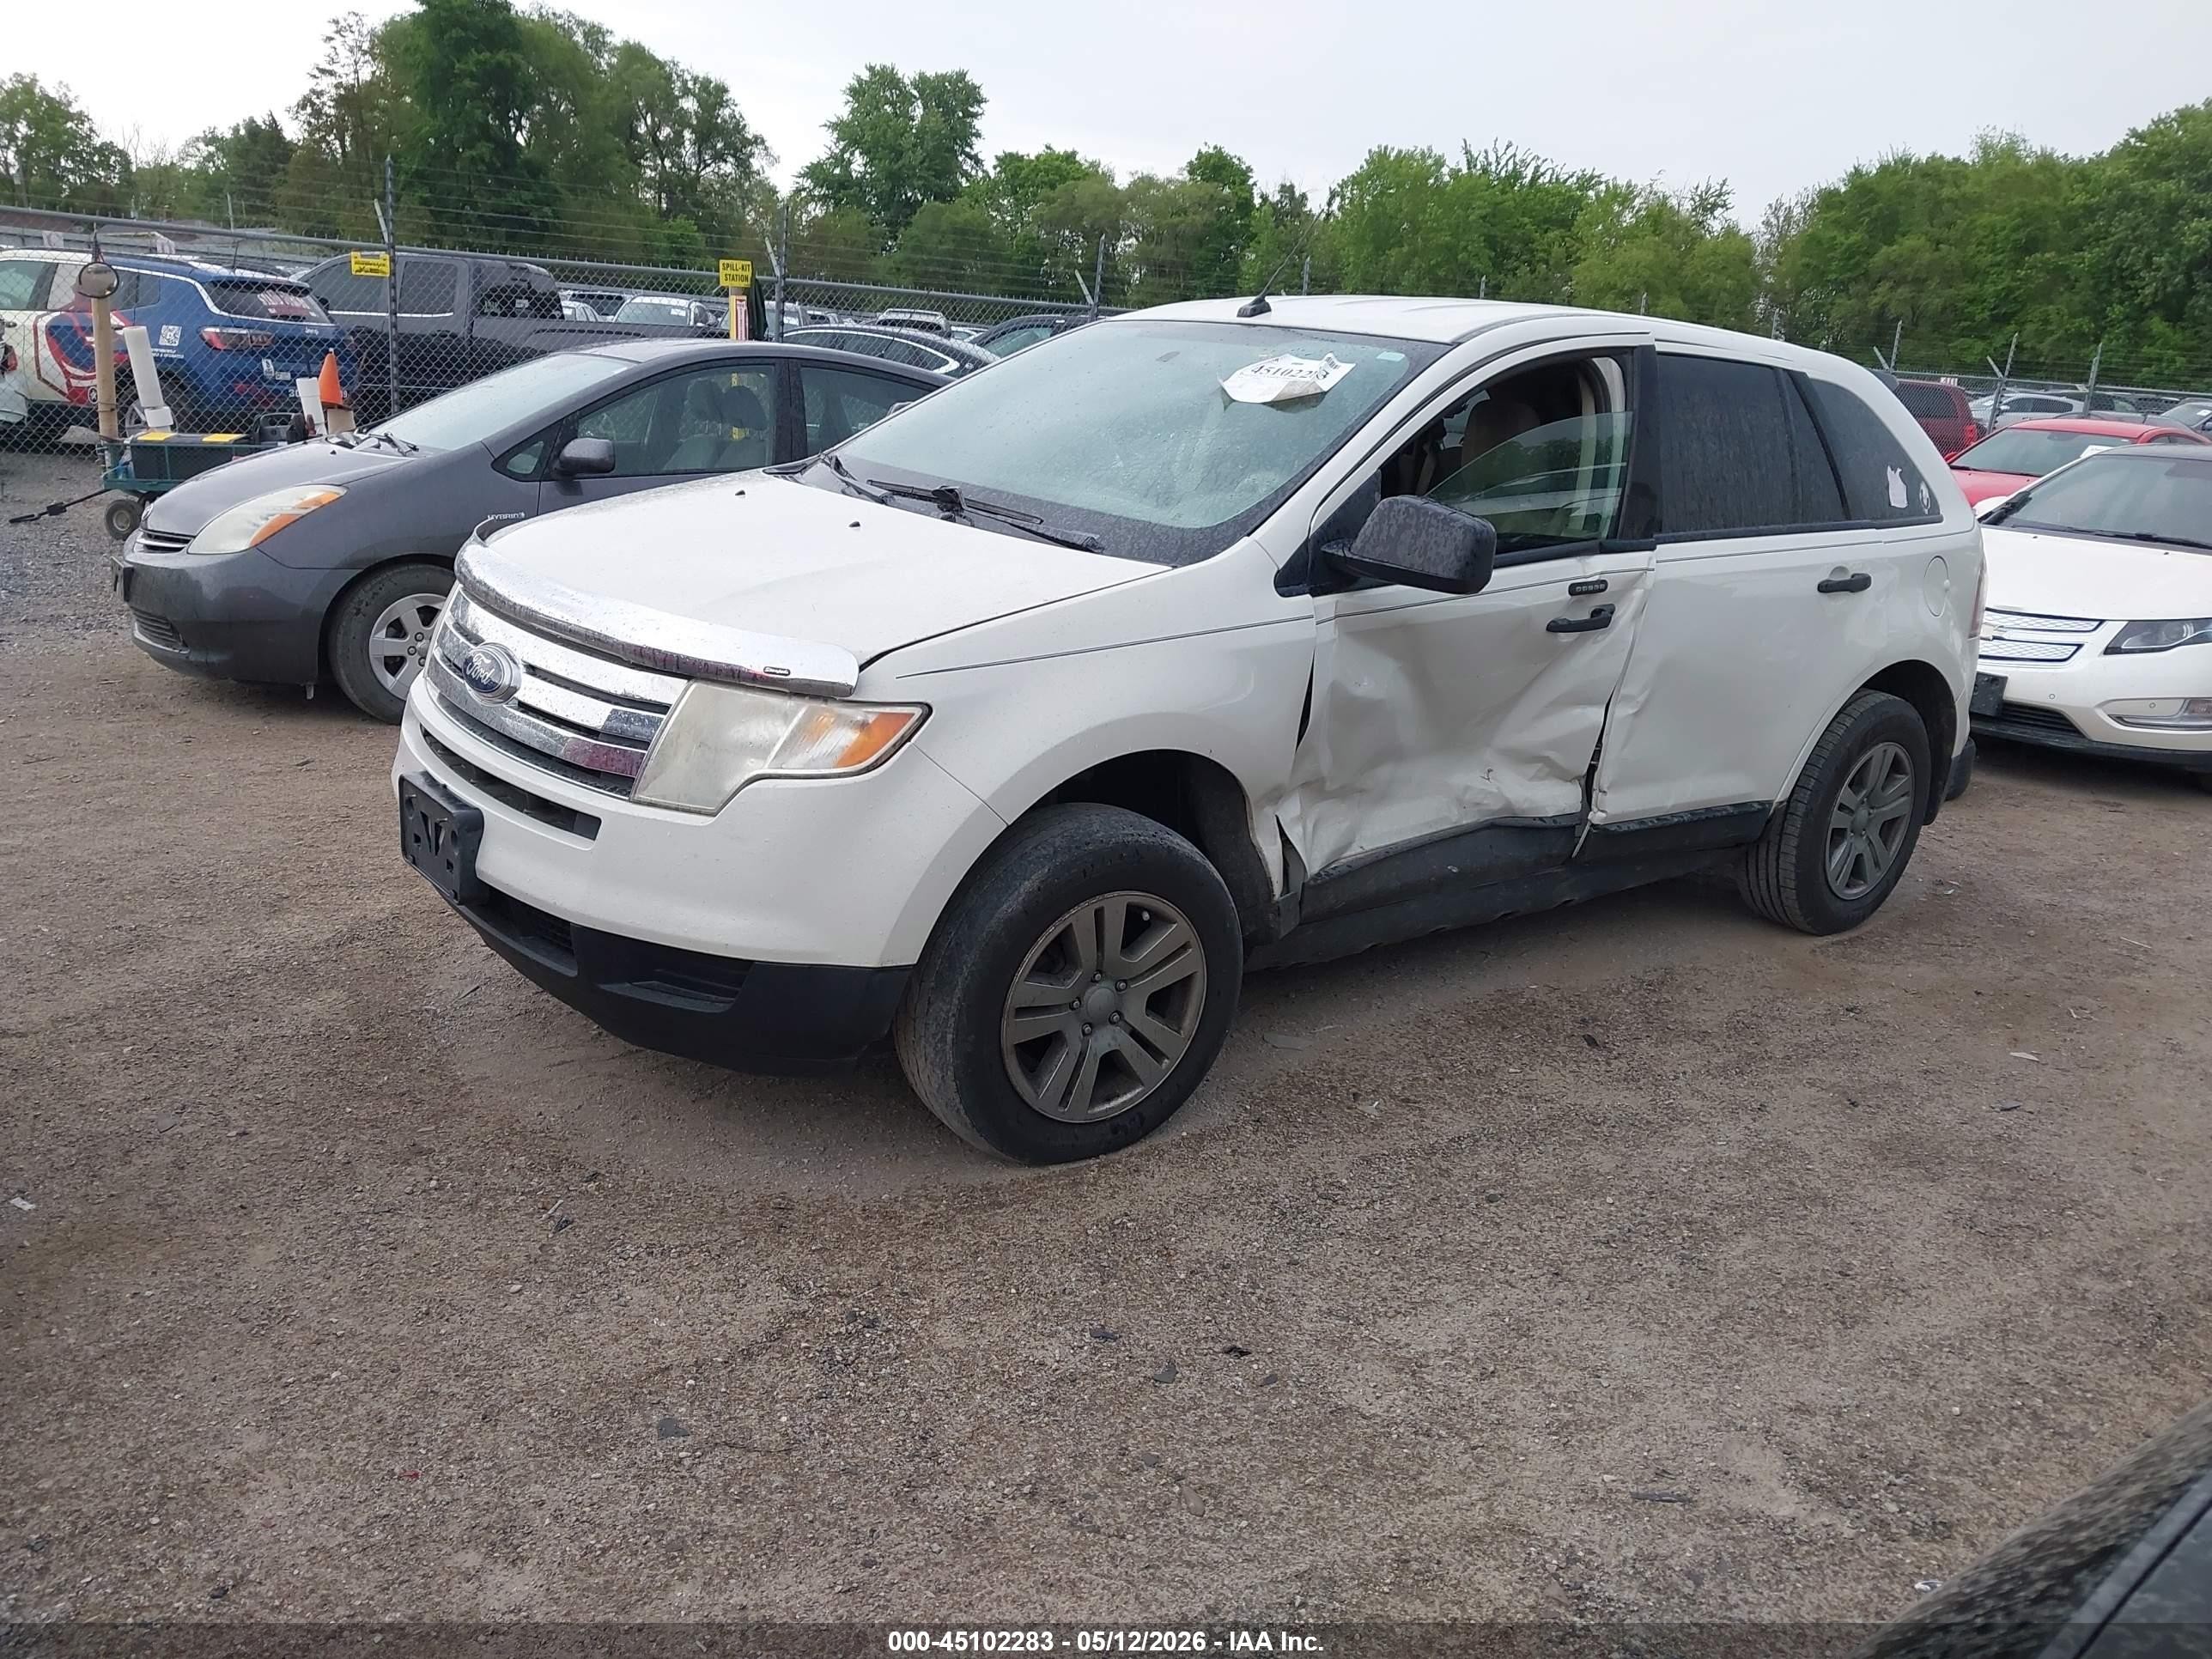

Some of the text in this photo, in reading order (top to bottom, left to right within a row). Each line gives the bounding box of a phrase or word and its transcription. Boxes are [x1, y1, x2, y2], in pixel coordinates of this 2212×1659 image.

[721, 262, 750, 272] SPILL-KIT
[724, 273, 749, 283] STATION
[465, 653, 495, 685] Ford
